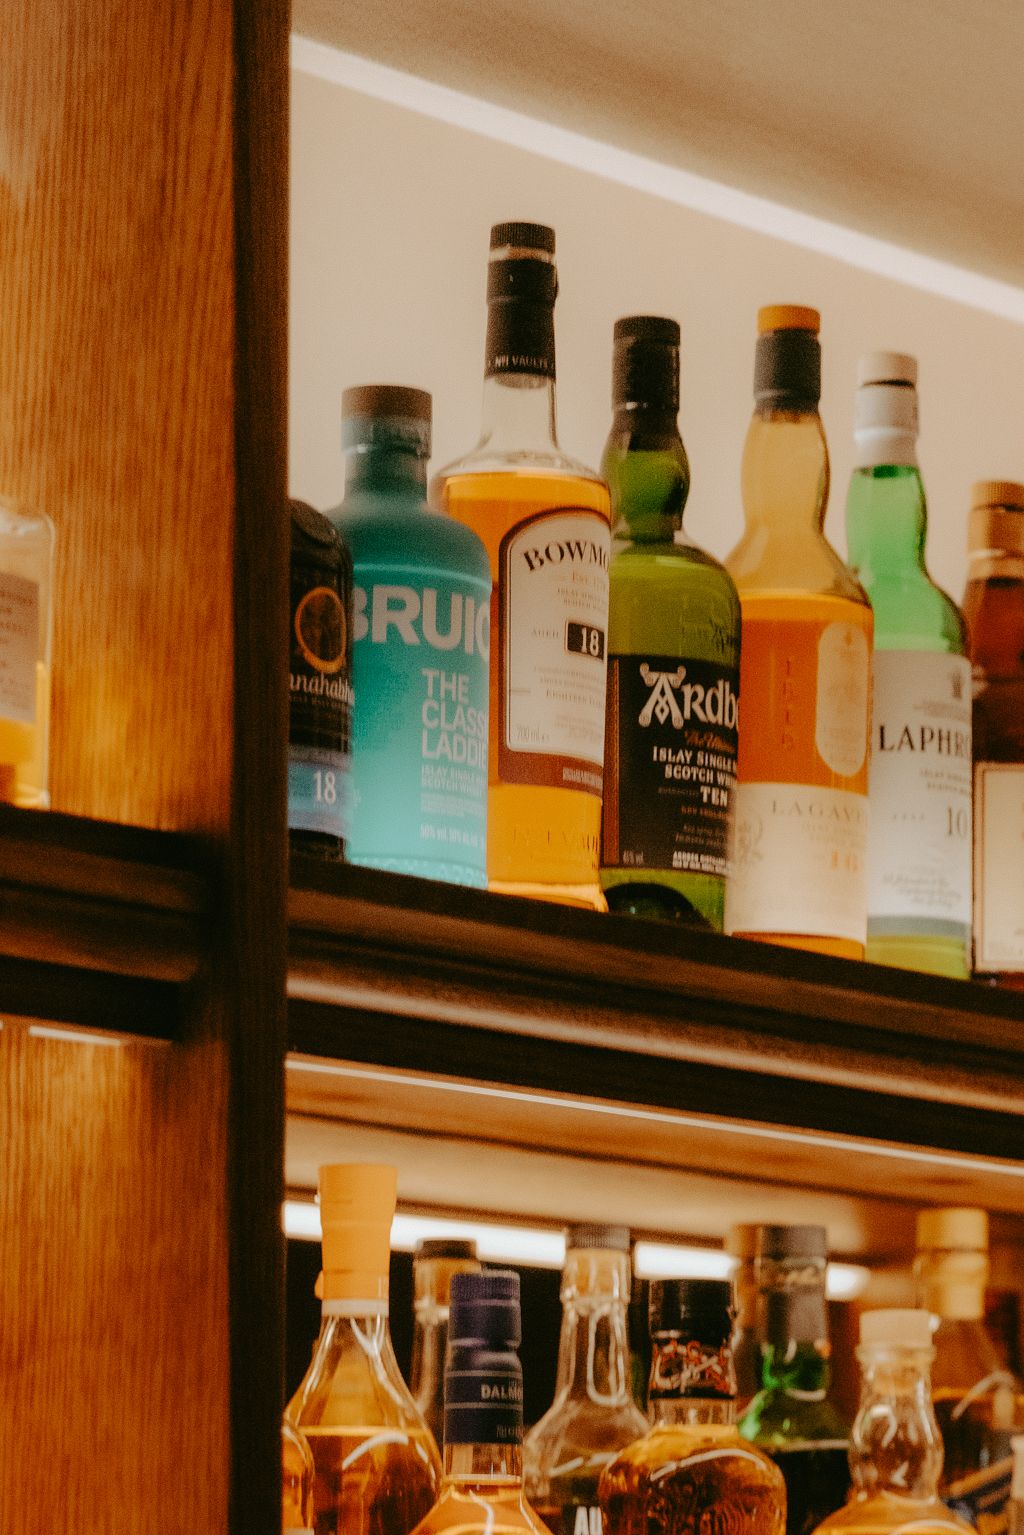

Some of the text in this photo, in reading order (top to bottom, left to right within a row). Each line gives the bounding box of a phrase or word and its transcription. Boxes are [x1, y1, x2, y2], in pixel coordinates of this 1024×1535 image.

[581, 627, 600, 658] 18
[421, 667, 470, 704] THE
[313, 771, 337, 804] 18
[665, 763, 714, 783] SCOTCH
[700, 785, 728, 808] TEN
[946, 805, 968, 838] 10
